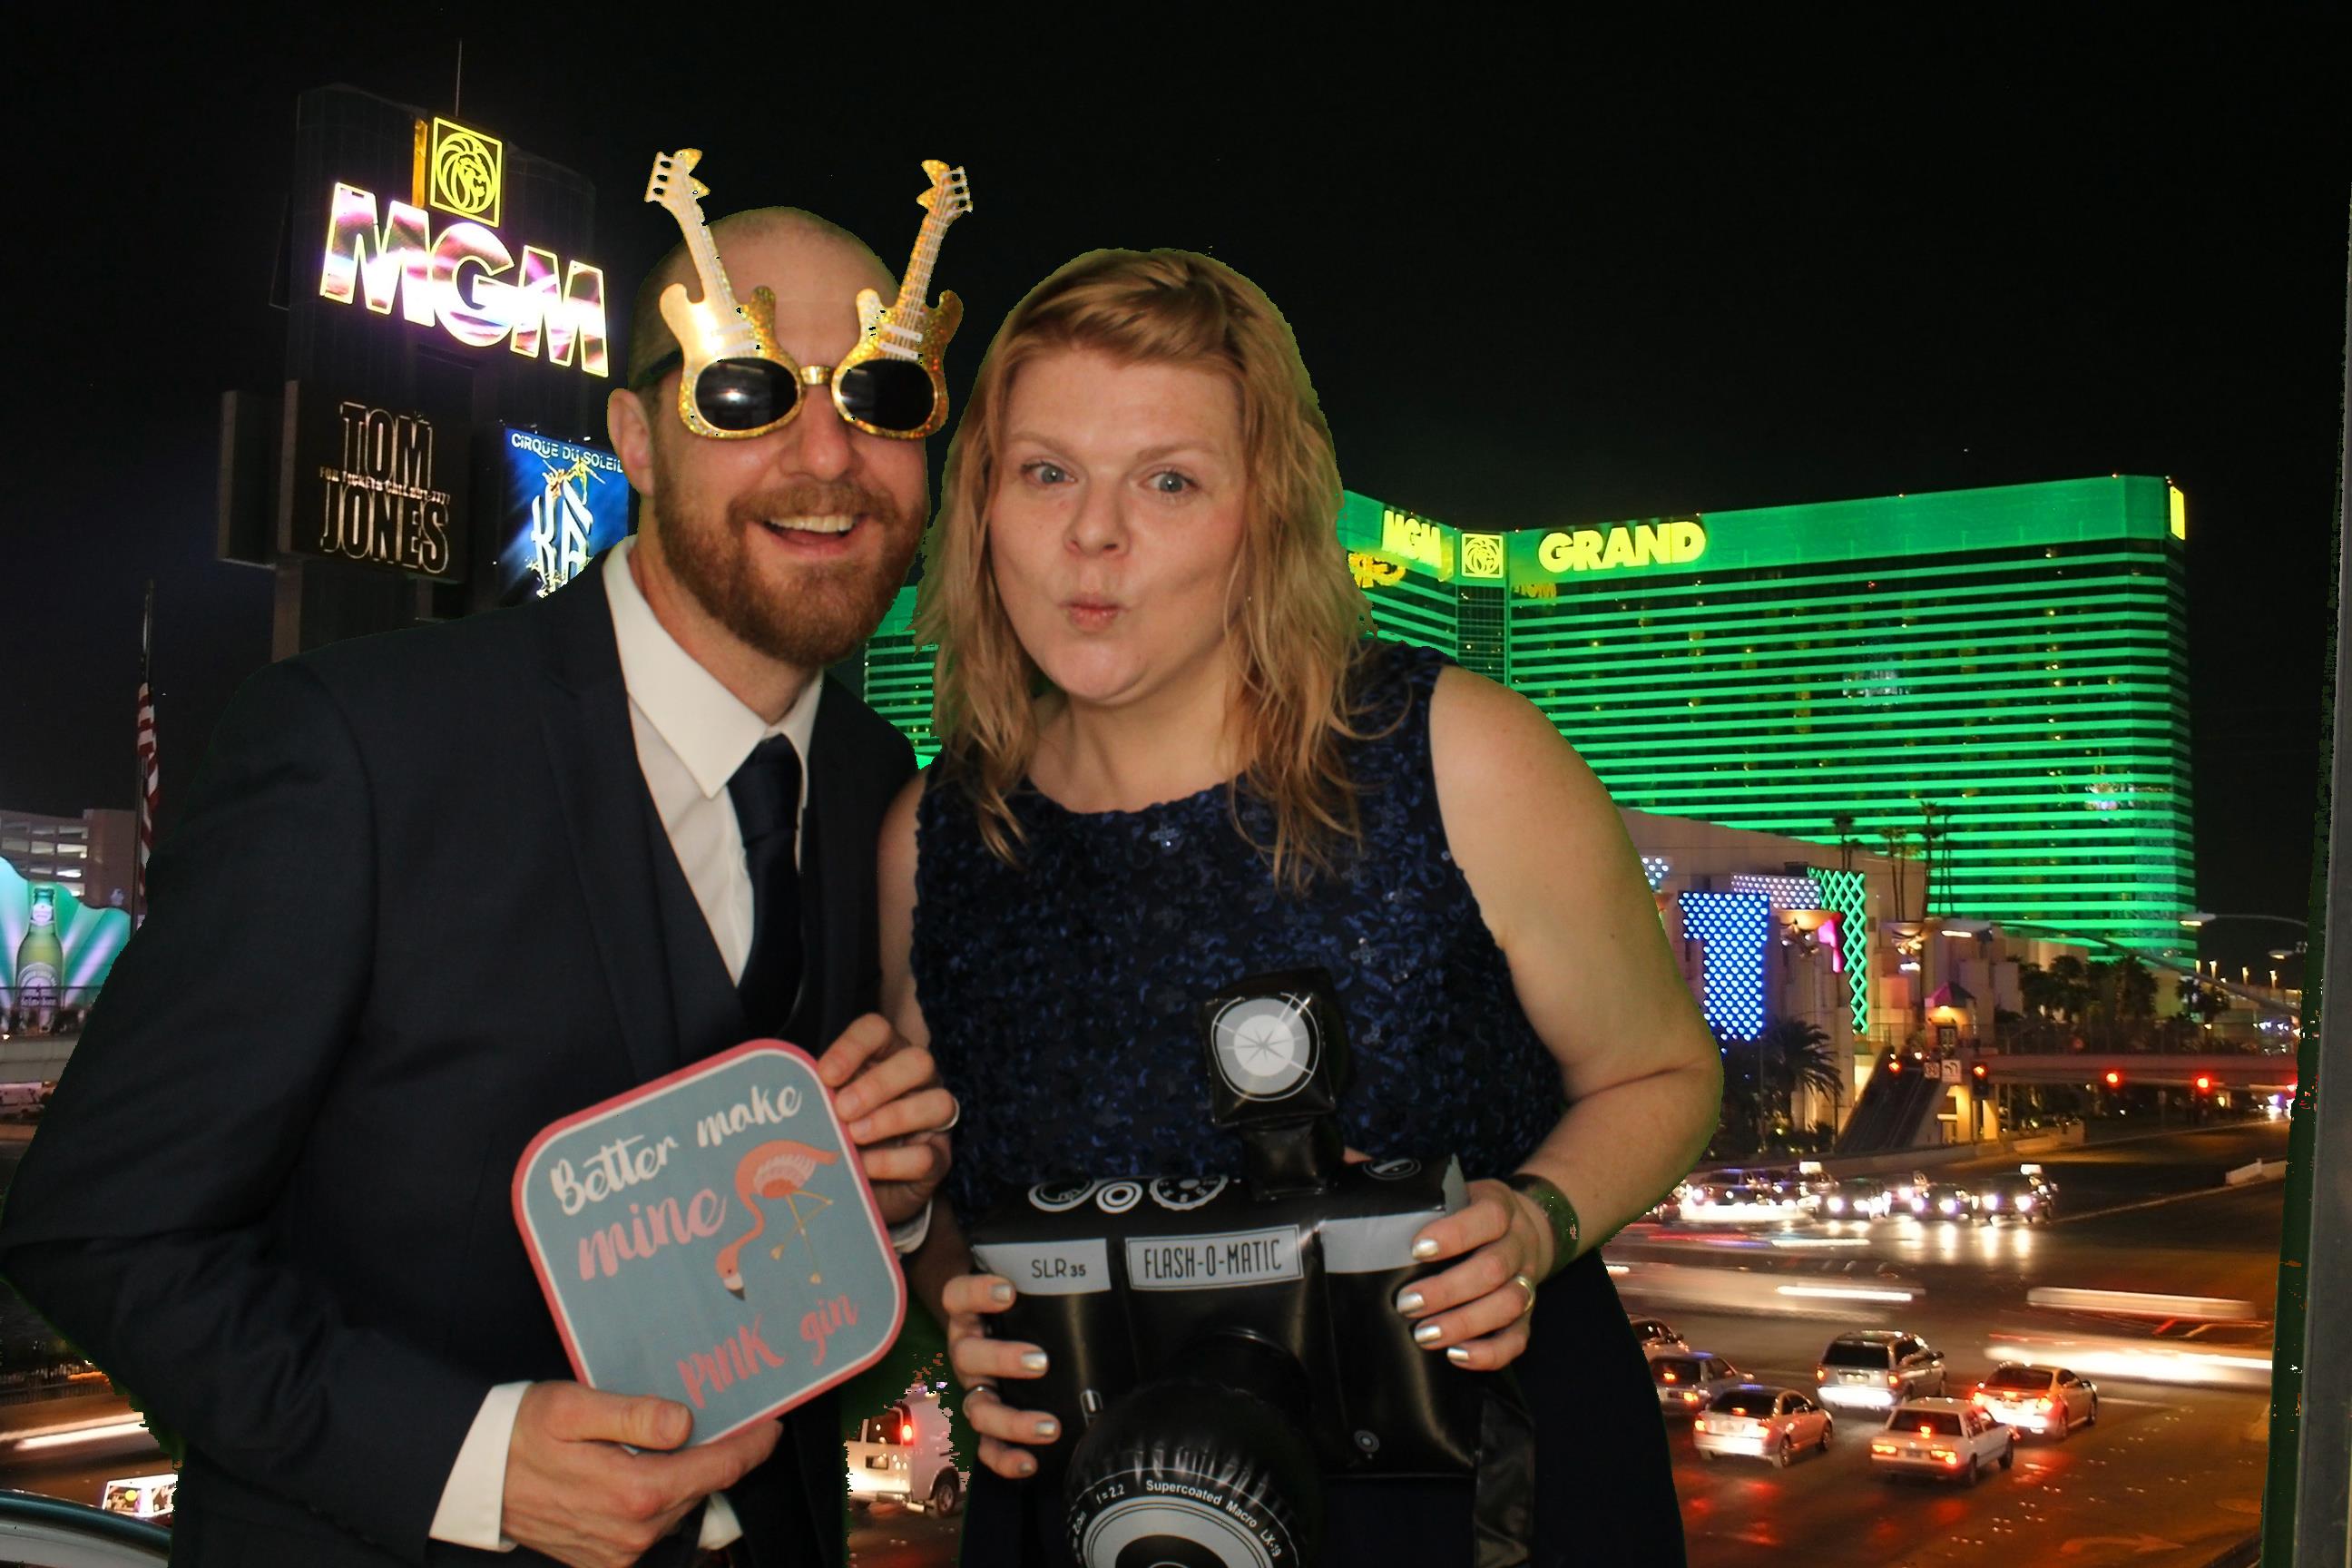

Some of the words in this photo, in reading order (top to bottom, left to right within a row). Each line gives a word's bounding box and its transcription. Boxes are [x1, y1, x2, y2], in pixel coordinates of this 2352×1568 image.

[319, 181, 609, 377] MGM
[319, 466, 340, 482] FOR
[339, 401, 433, 491] TOM
[511, 433, 560, 459] CIRQUE
[562, 446, 580, 462] DU
[319, 481, 449, 573] JONES
[1382, 510, 1442, 569] MGM
[1538, 521, 1706, 573] GRAND
[549, 1134, 678, 1216] Better
[696, 1085, 803, 1148] make
[578, 1188, 727, 1281] mine
[1144, 1239, 1282, 1279] FLASH-O-MATIC
[1031, 1258, 1066, 1279] SLR
[1070, 1264, 1086, 1278] 35
[799, 1294, 859, 1365] gin
[1145, 1479, 1223, 1506] Supercoated
[1226, 1500, 1258, 1528] Macro
